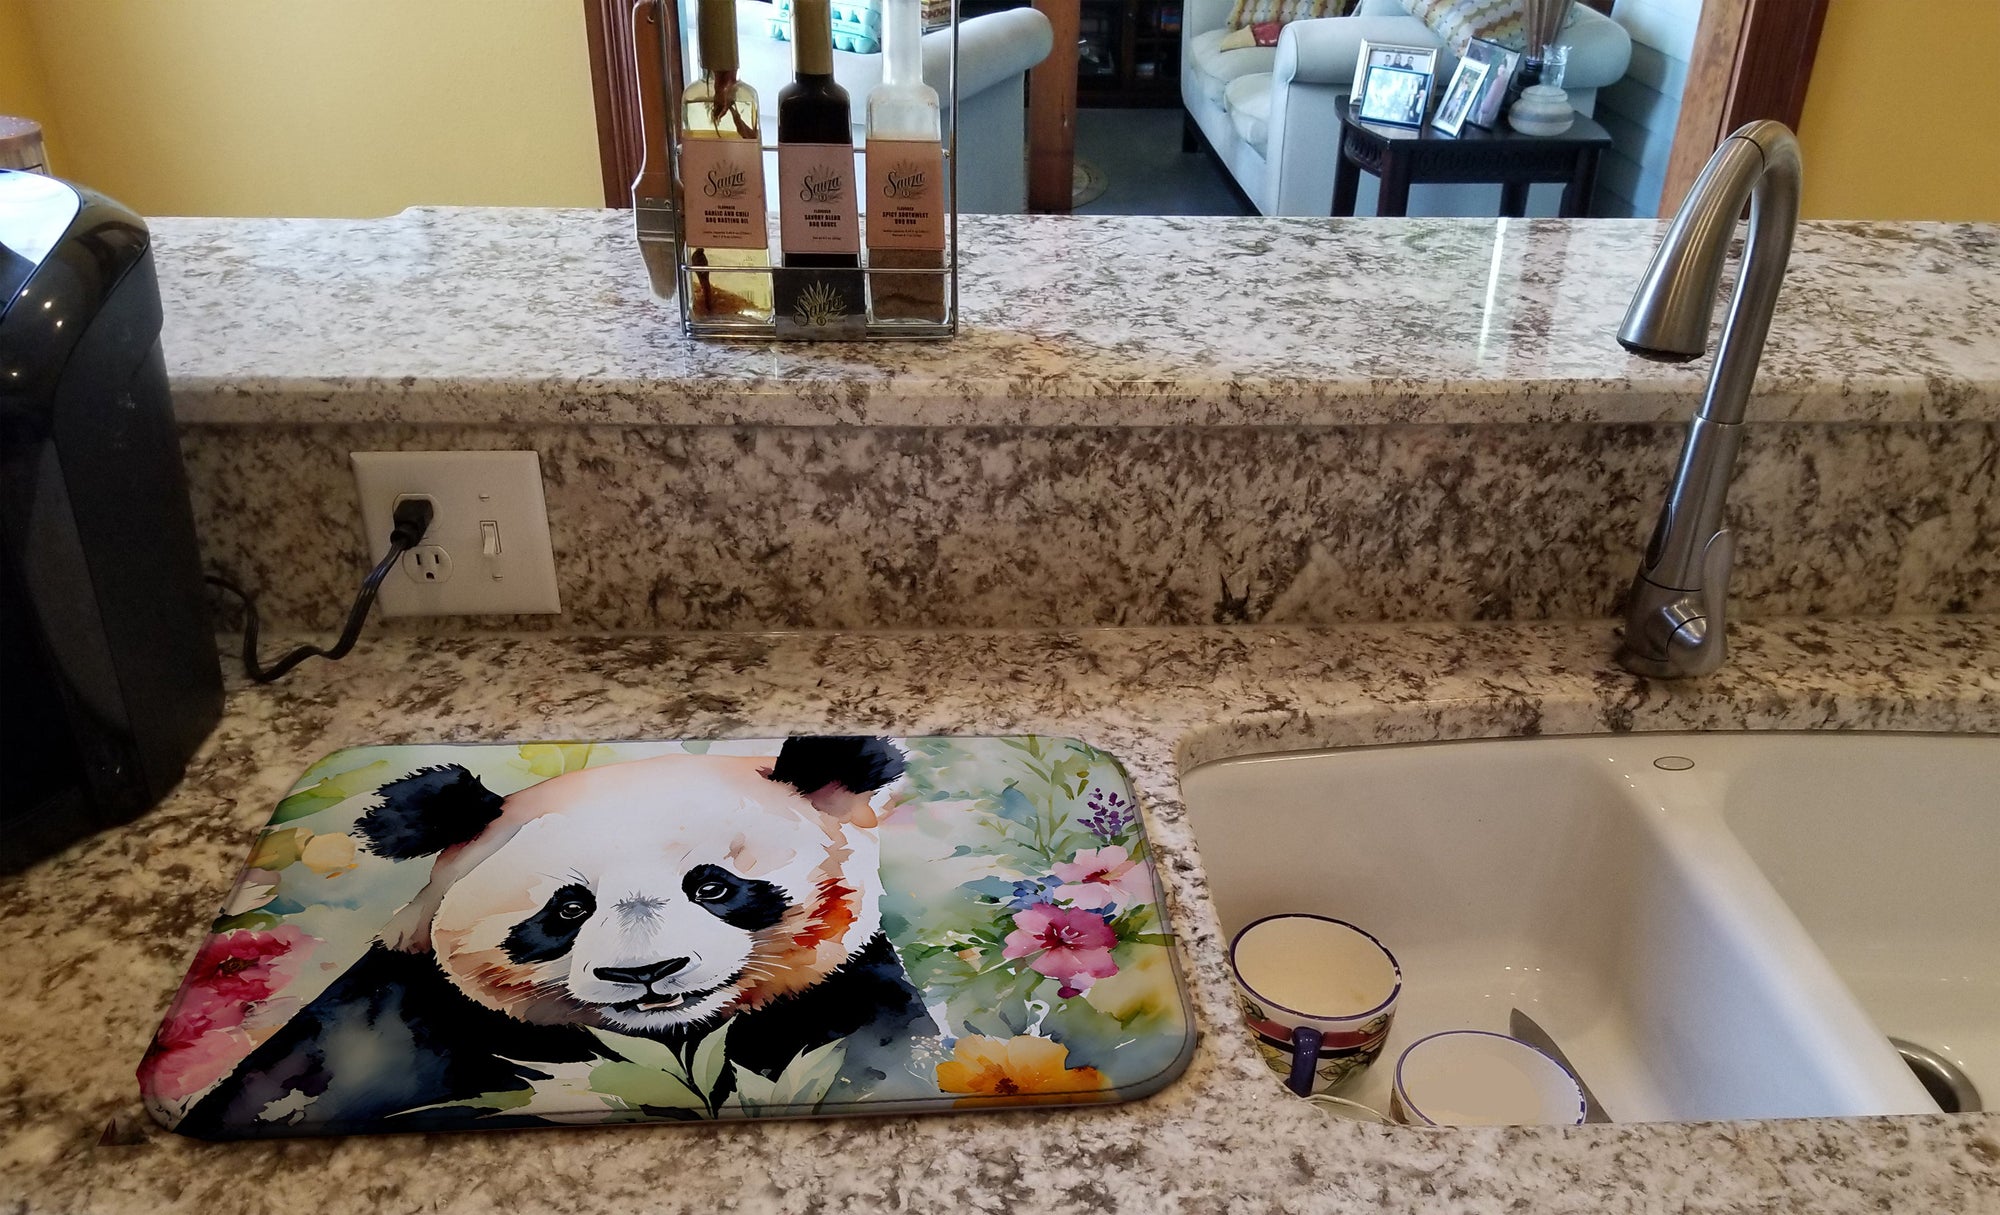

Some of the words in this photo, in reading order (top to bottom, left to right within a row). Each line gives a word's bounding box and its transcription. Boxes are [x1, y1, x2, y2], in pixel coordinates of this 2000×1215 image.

[704, 170, 746, 197] Sauza
[800, 175, 841, 202] Sauza
[884, 171, 926, 198] Sauza
[793, 295, 843, 327] Sauza
